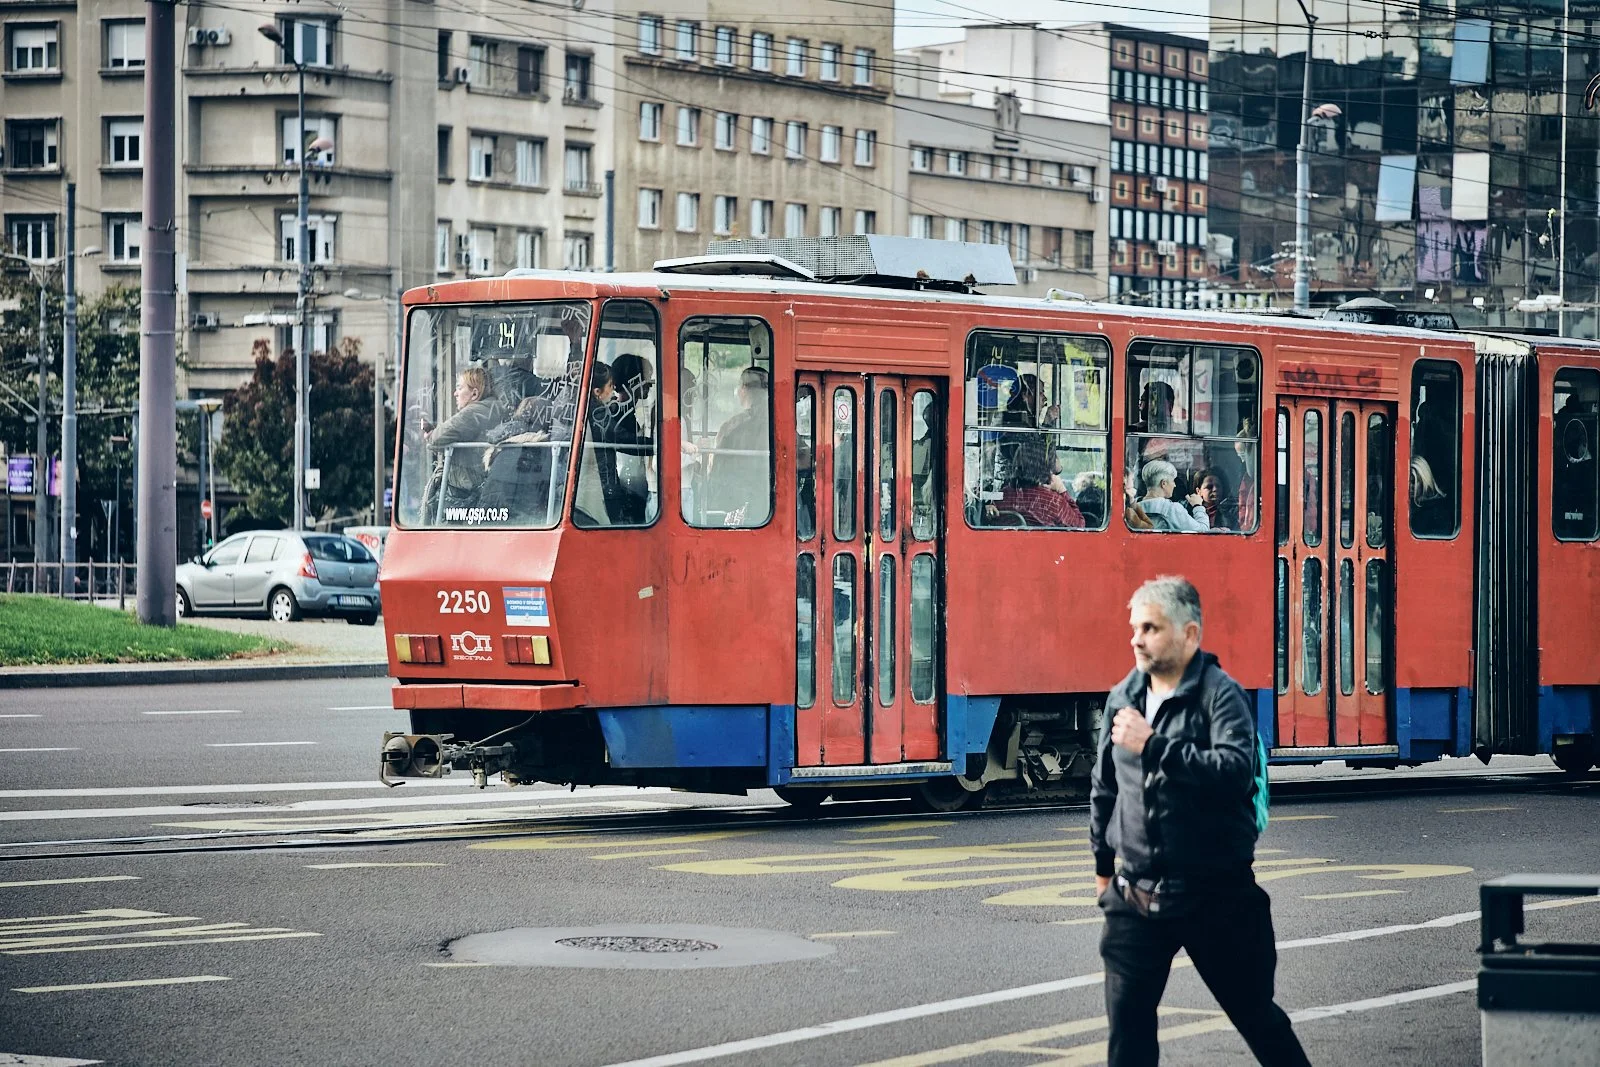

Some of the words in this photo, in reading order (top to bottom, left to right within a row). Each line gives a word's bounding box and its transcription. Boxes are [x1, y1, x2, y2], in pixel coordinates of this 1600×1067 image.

[499, 322, 515, 349] 14
[445, 507, 509, 525] www.gsp.co.rs
[437, 590, 490, 614] 2250
[450, 630, 493, 656] ГСП
